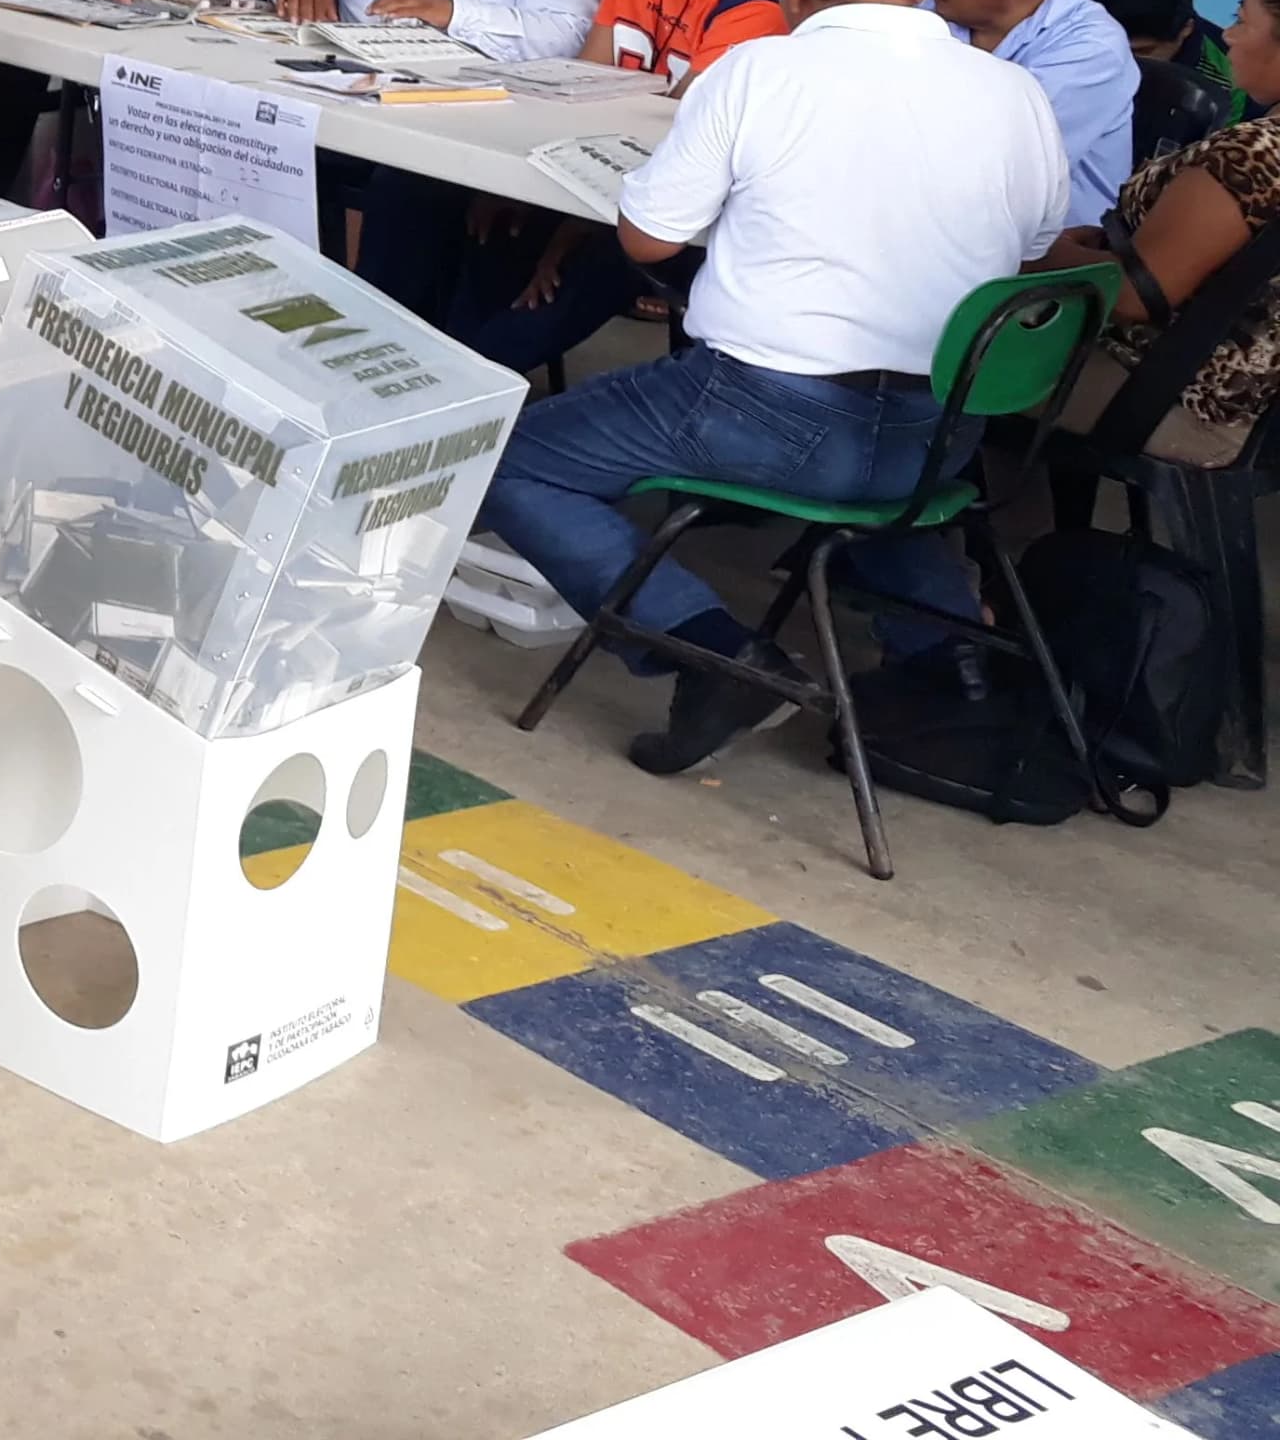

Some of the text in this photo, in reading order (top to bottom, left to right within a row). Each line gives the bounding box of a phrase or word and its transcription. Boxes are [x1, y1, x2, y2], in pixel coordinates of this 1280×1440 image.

[130, 71, 162, 92] INE
[108, 117, 119, 127] un
[120, 120, 155, 137] derecho
[233, 149, 248, 163] del
[250, 155, 304, 177] ciudadano
[127, 104, 279, 155] Votar en las elecciones constituye
[26, 292, 287, 489] PRESIDENCIA MUNICIPAL
[369, 373, 443, 399] BOLETA
[63, 372, 209, 497] Y REGIDURÍAS
[331, 415, 506, 501] PRESIDENCIA MUNICIPAL
